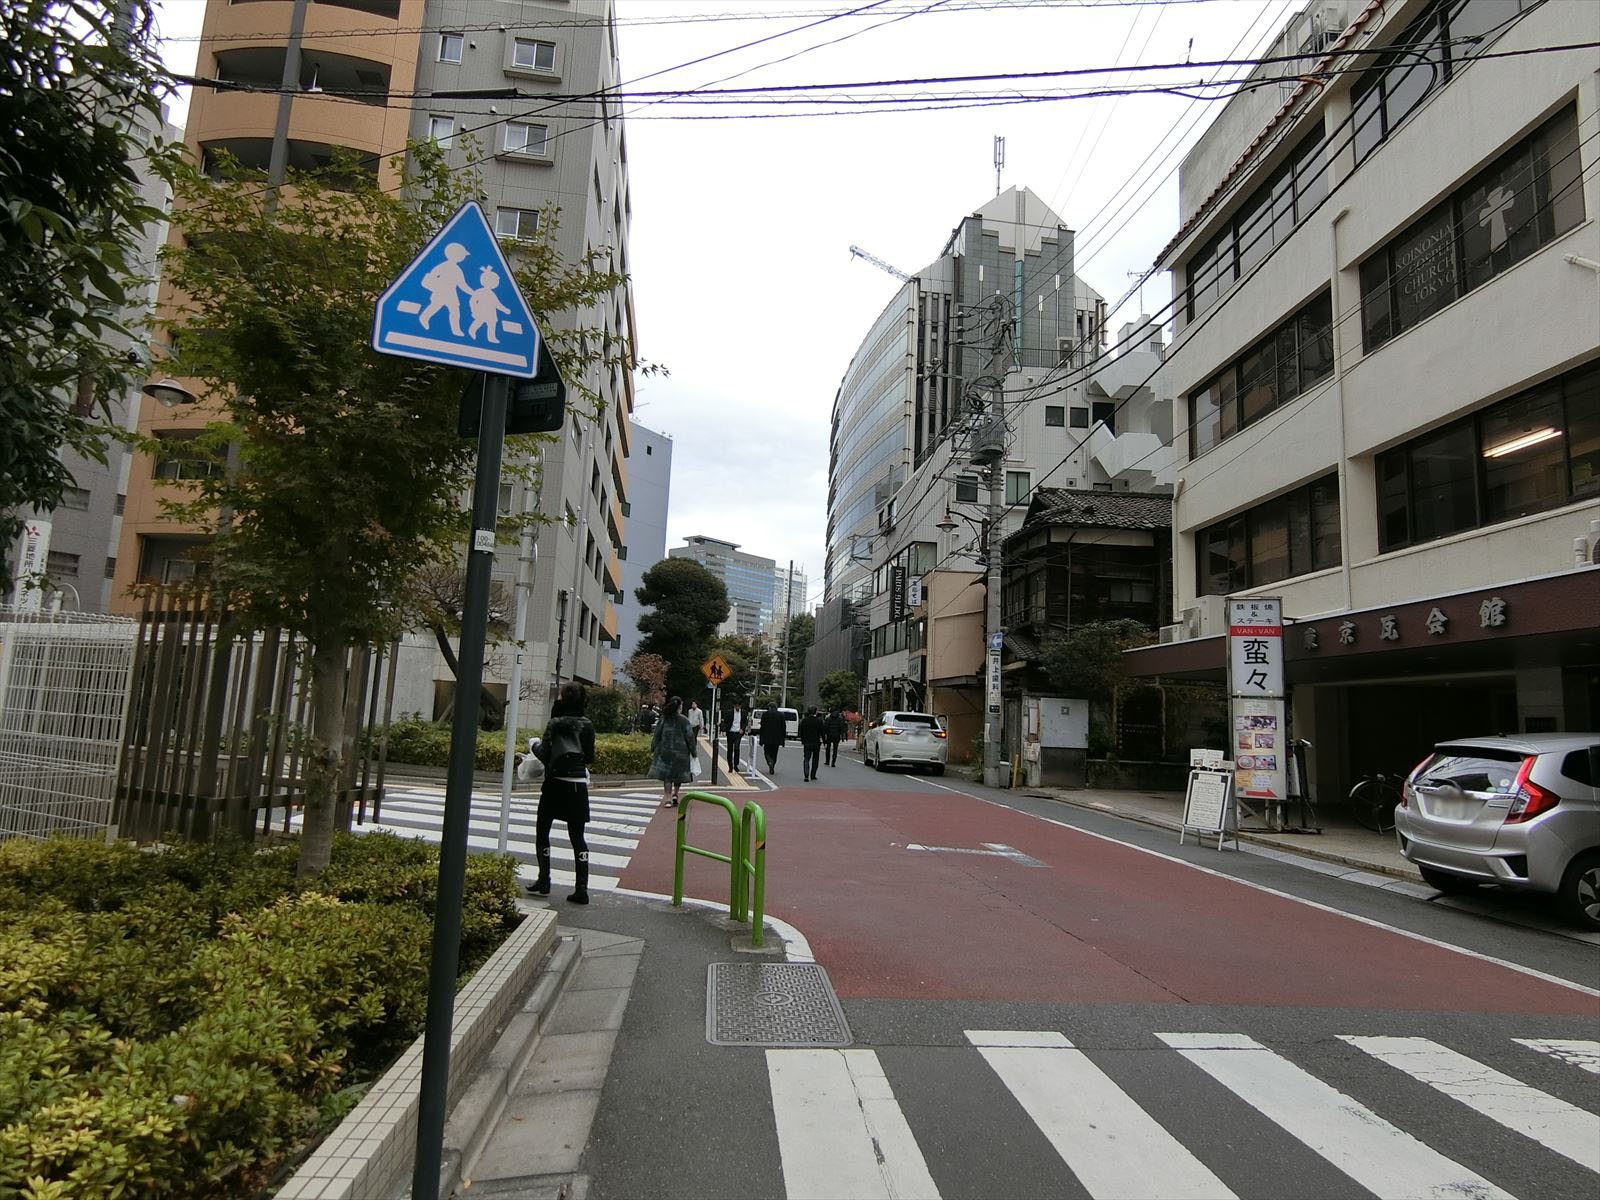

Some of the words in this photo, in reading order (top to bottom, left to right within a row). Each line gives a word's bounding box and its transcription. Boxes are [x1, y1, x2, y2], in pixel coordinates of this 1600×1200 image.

[1396, 224, 1454, 272] KOINONIA
[1404, 253, 1454, 294] CHURCH
[1413, 269, 1455, 303] TOKYO
[895, 569, 903, 593] PARIS
[1236, 617, 1273, 625] ステーキ
[1304, 596, 1507, 650] 東京瓦会館
[1243, 638, 1269, 690] 蛮々
